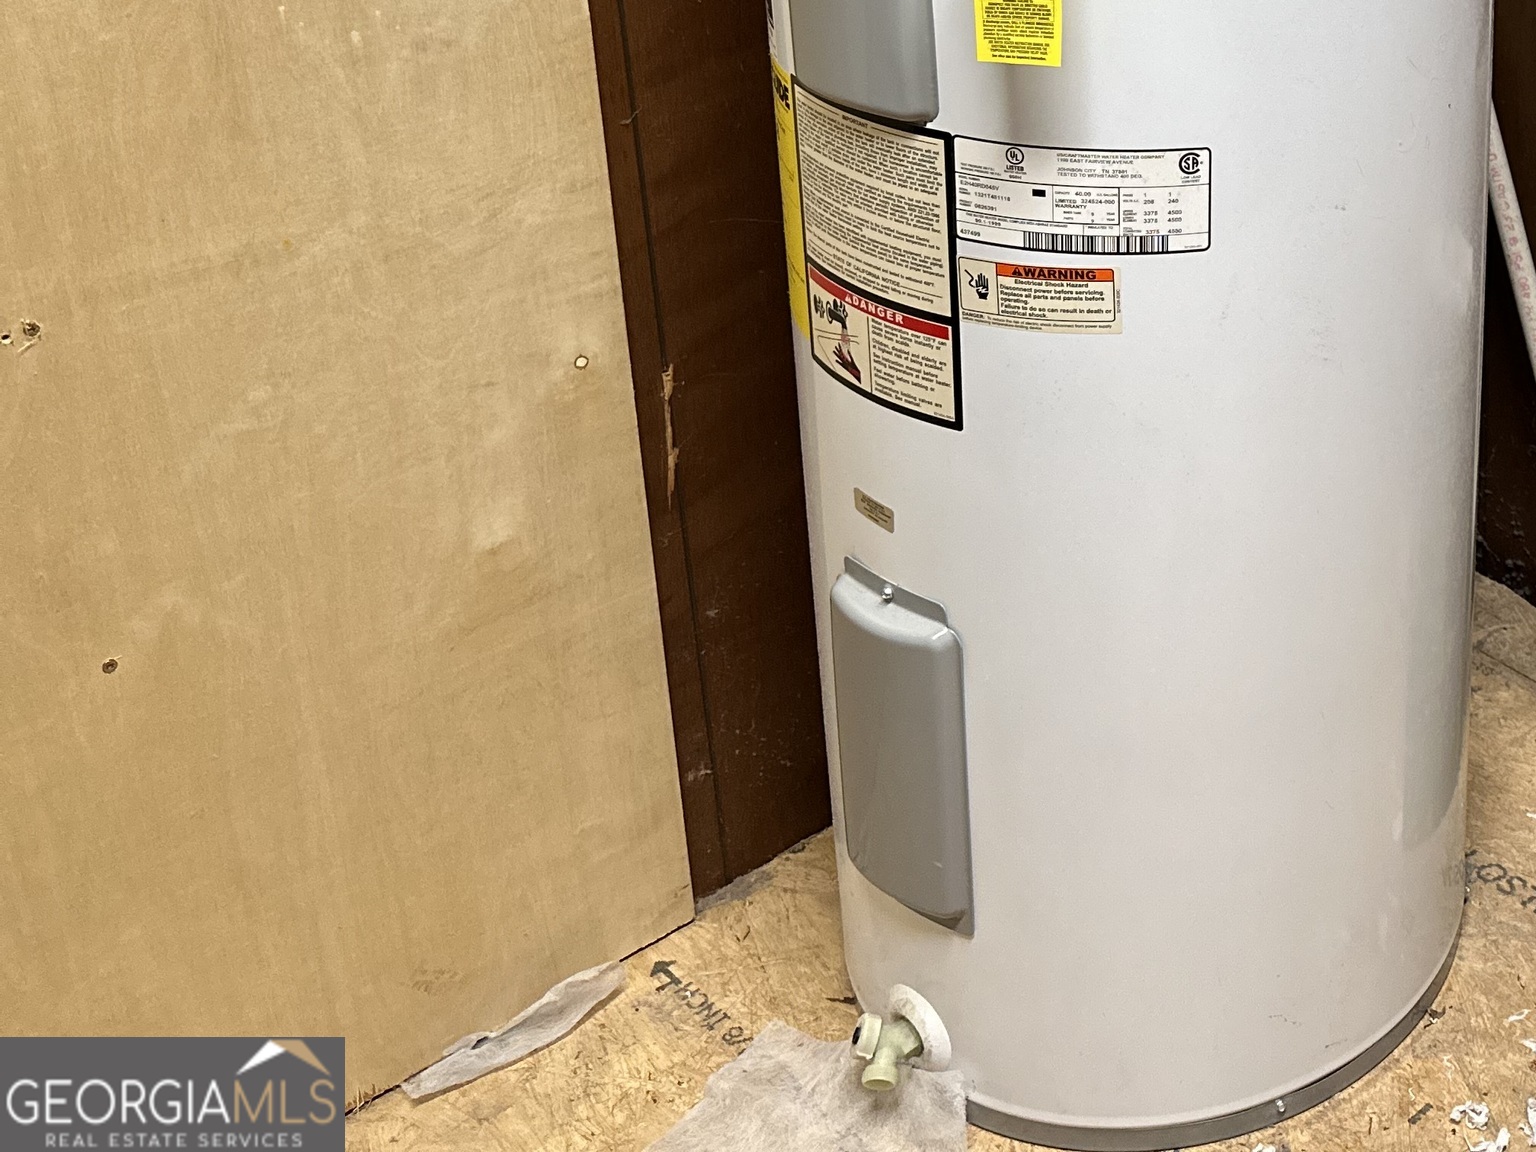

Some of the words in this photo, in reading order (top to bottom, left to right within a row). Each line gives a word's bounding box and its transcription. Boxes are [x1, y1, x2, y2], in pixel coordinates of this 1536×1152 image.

[842, 114, 868, 129] IMPORTANT
[1023, 267, 1097, 280] WARNING
[881, 276, 900, 287] NOTICE
[1000, 284, 1032, 292] Disconnect
[1000, 290, 1023, 298] Replace
[1000, 297, 1029, 305] operating.
[852, 295, 904, 324] DANGER
[674, 980, 731, 1031] INCH
